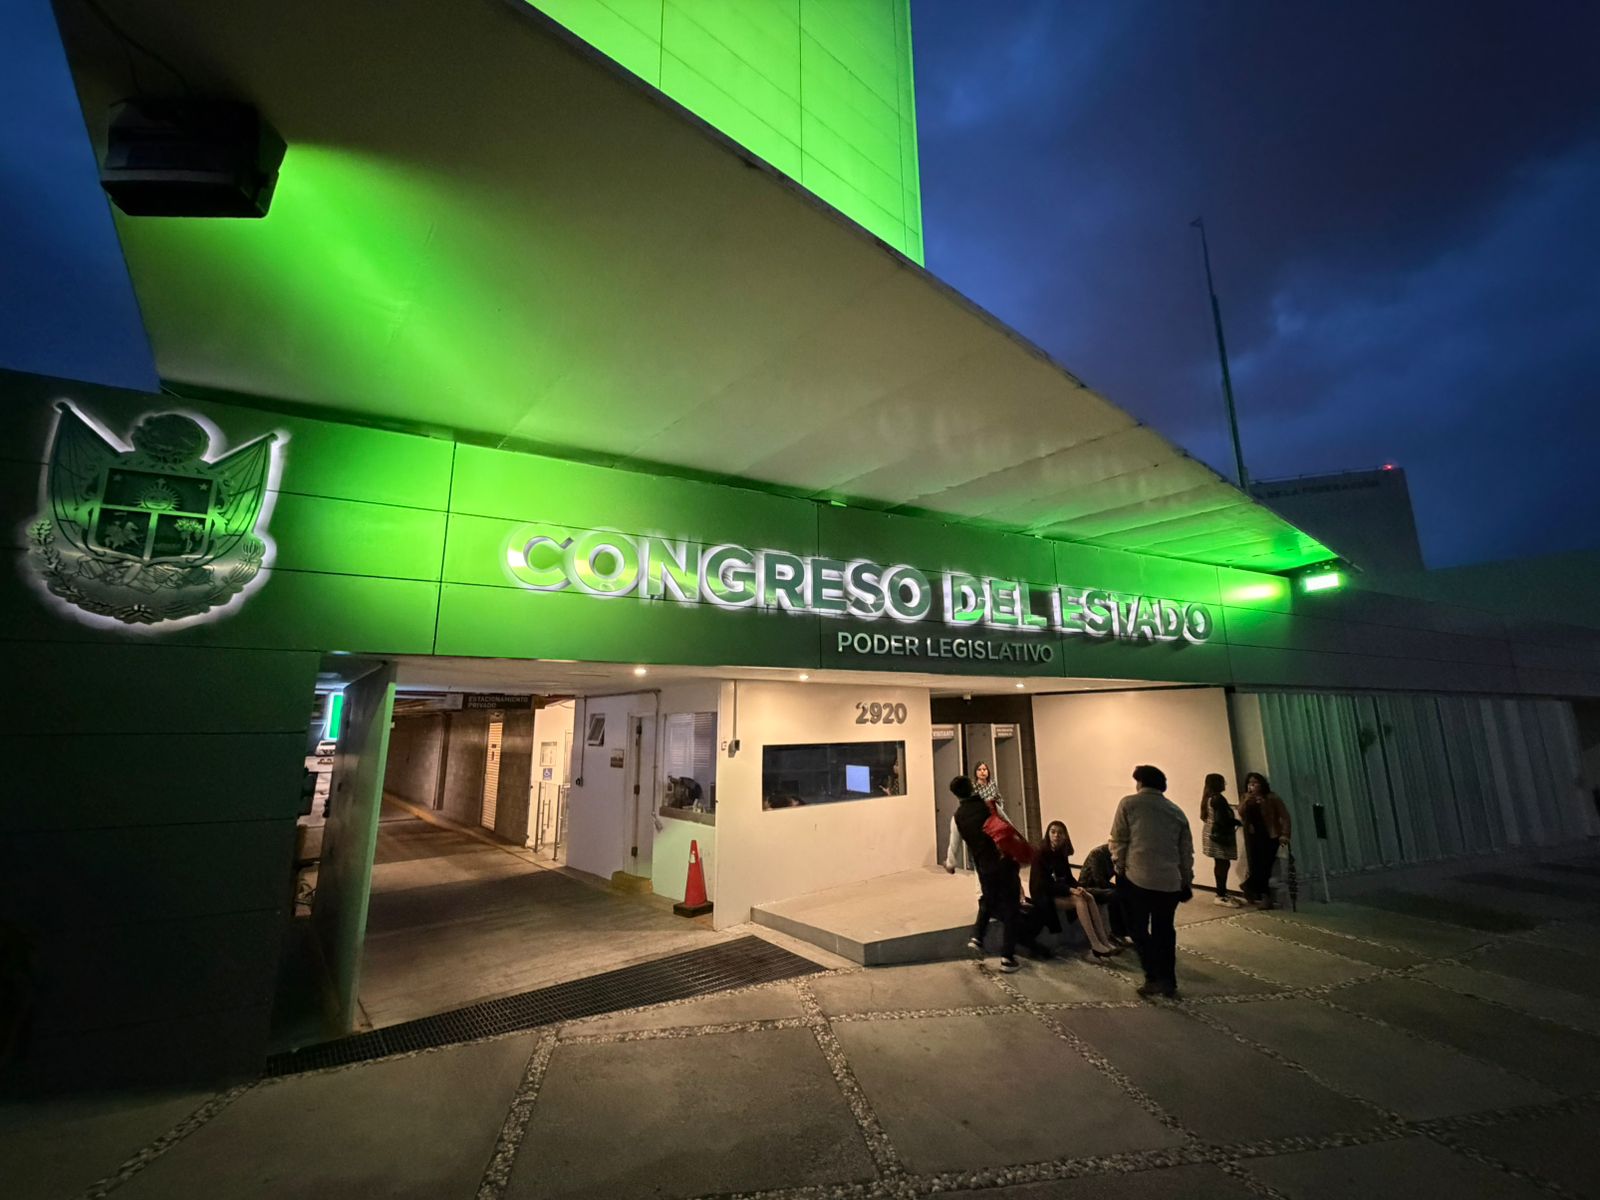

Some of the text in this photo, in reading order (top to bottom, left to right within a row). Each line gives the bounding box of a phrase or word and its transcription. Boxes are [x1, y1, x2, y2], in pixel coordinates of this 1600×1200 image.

[506, 523, 1213, 645] CONGRESO DEL ESTADO
[838, 632, 1054, 663] PODER LEGISLATIVO
[855, 702, 908, 725] 2920
